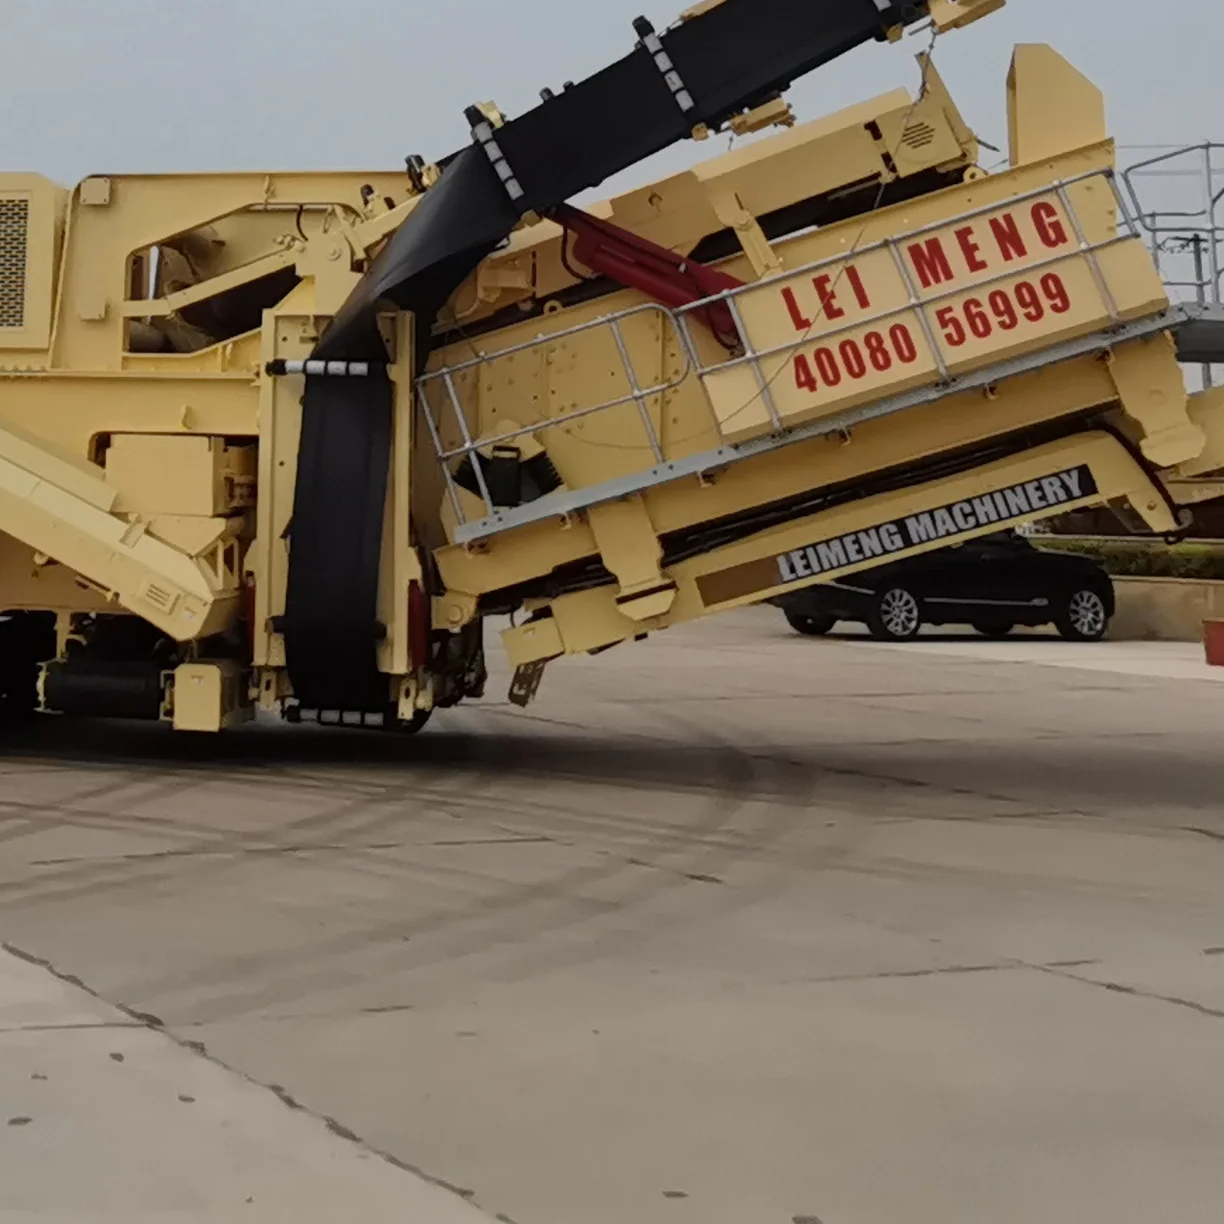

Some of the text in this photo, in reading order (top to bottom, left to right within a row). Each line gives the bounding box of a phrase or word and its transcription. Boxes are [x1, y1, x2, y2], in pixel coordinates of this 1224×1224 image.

[781, 202, 1068, 331] LEI MENG
[793, 272, 1070, 393] 40080 56999
[777, 469, 1083, 582] LEIMENG MACHINERY
